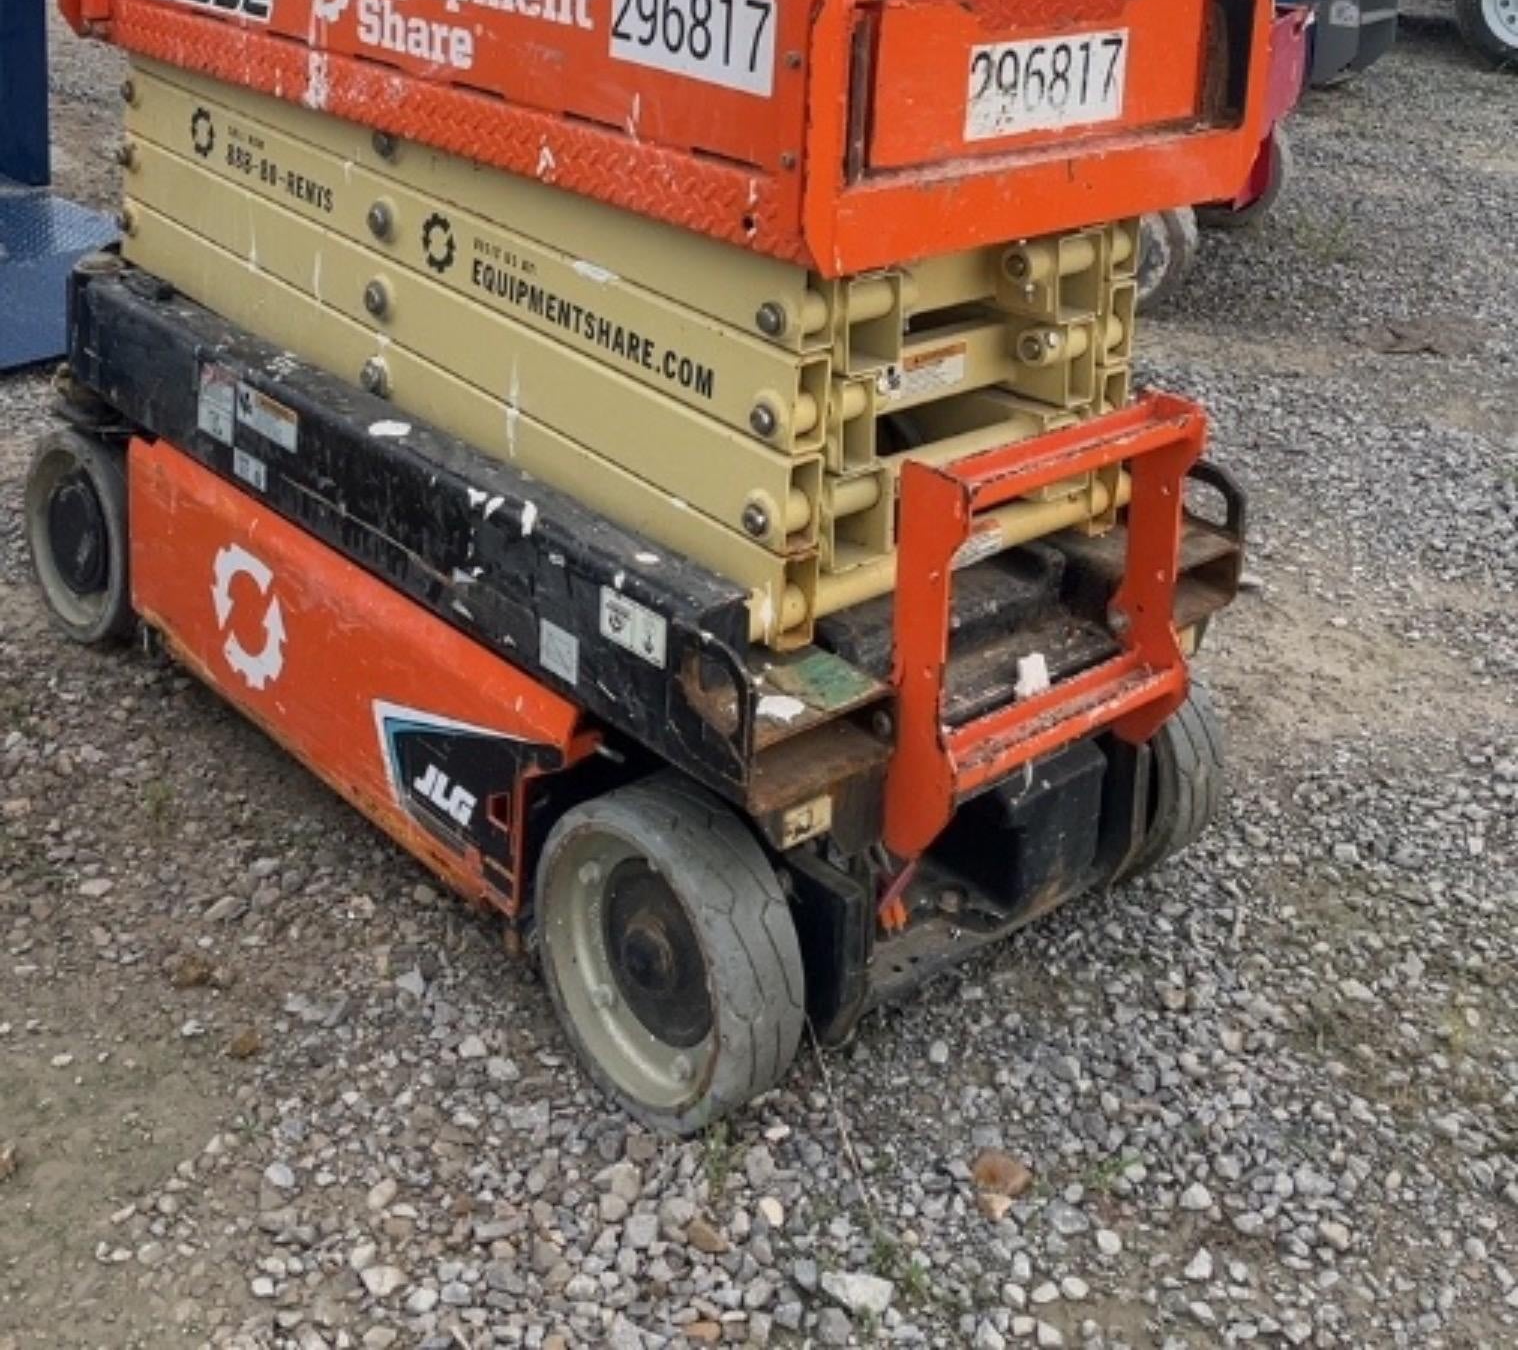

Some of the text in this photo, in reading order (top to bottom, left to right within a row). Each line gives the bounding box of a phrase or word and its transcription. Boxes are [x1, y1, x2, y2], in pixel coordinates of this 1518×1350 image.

[970, 38, 1124, 107] 296817
[471, 256, 716, 400] EQUIPMENTSHARE.COM
[413, 763, 478, 827] JLG
